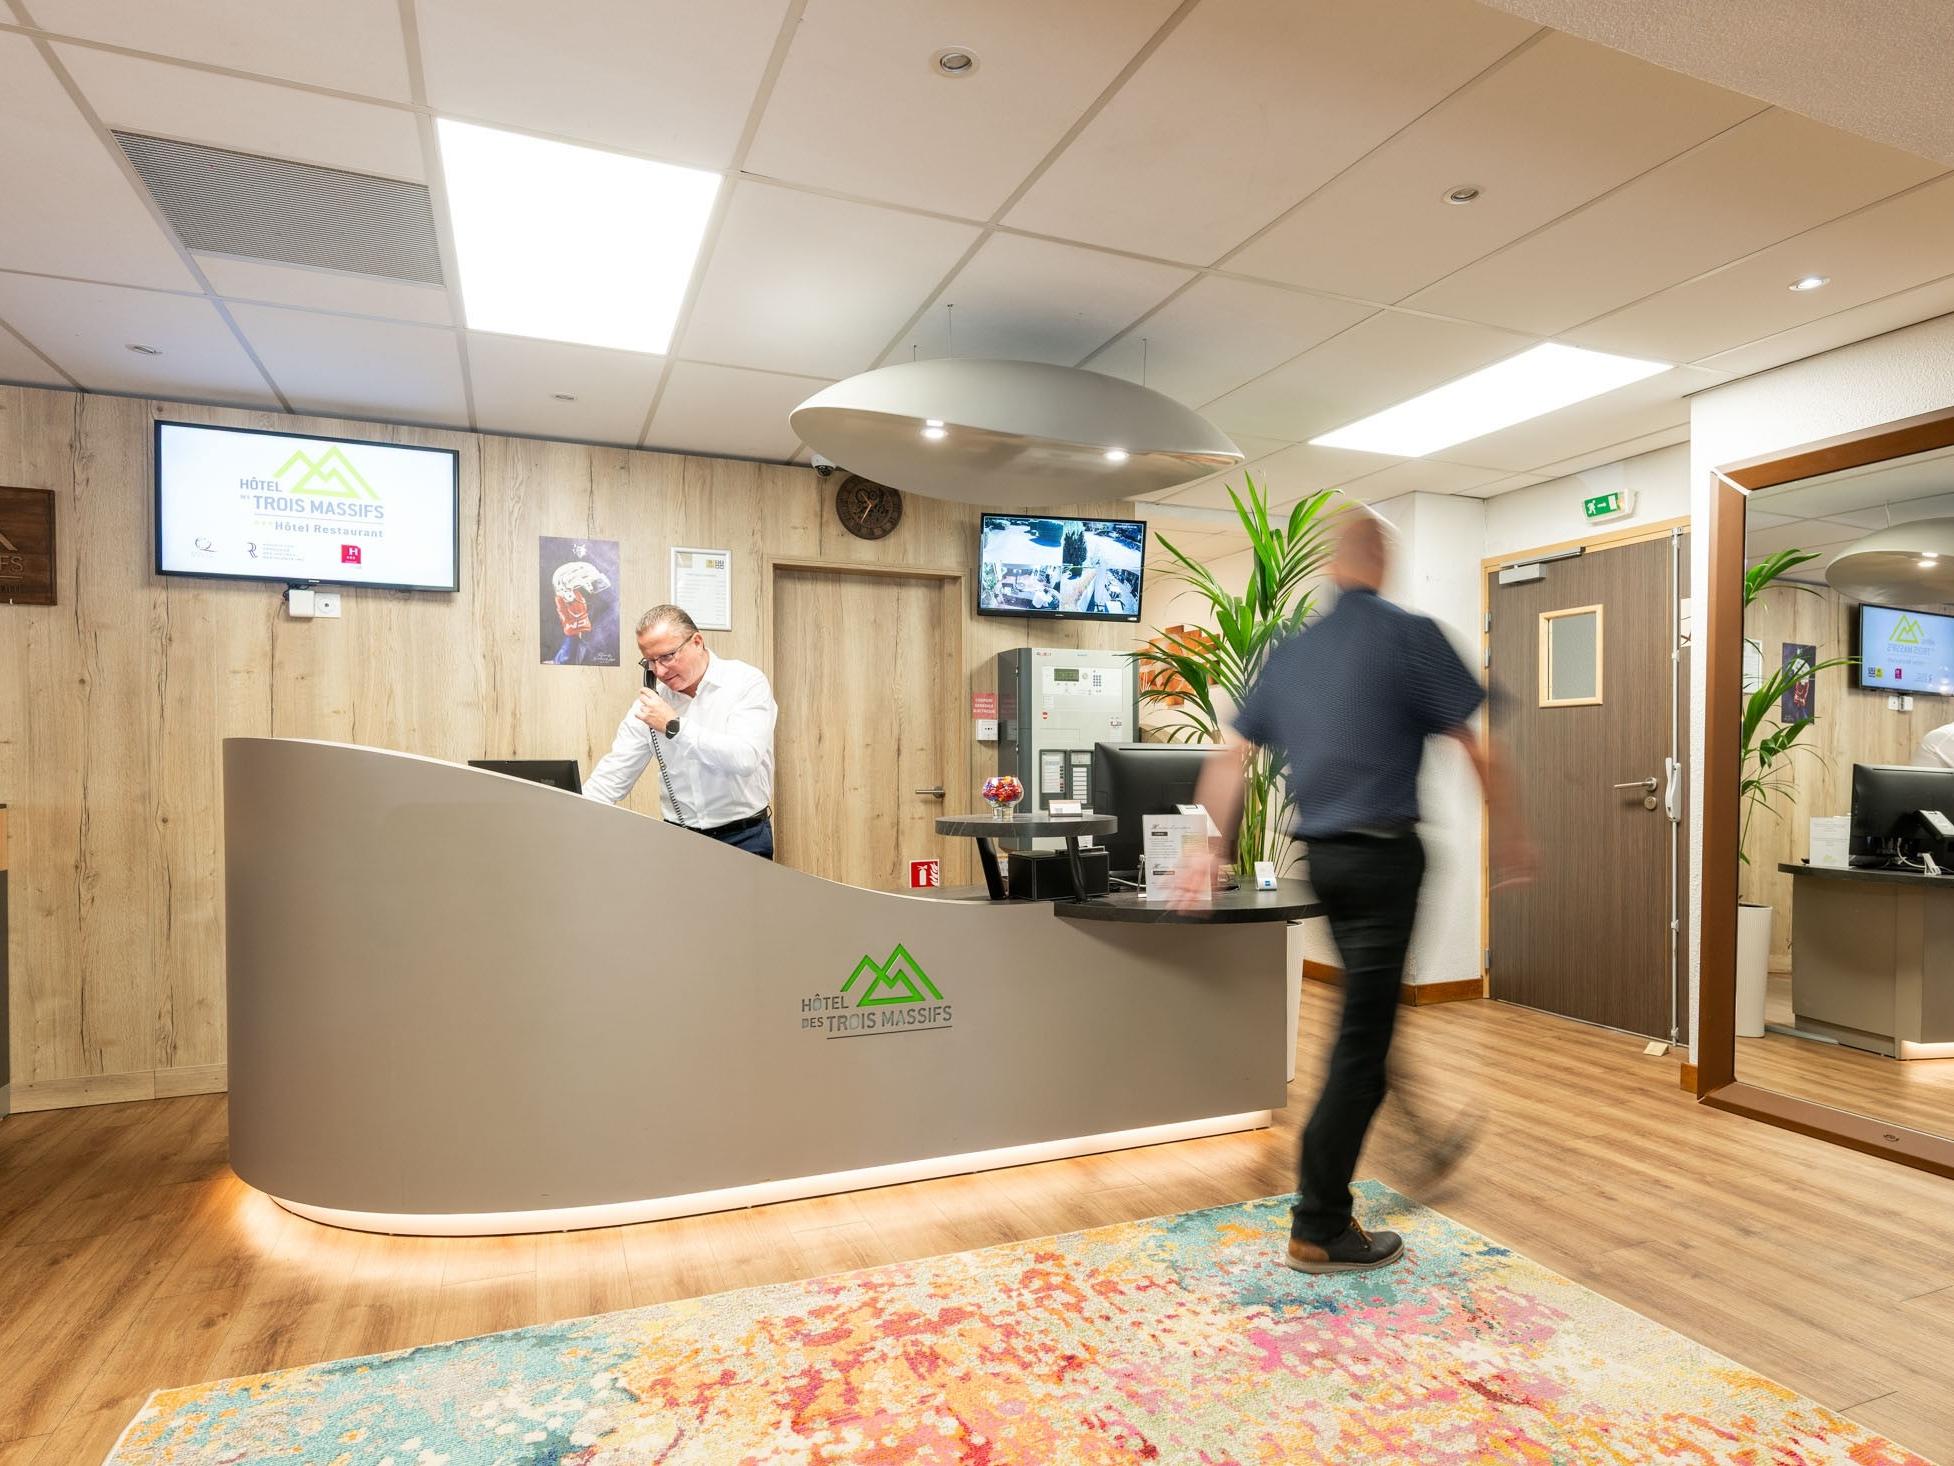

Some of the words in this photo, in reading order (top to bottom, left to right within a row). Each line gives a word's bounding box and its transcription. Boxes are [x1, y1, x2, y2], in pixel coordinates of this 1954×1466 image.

[240, 476, 283, 493] HÔTEL
[253, 495, 305, 513] TROIS
[311, 500, 385, 519] MASSIFS
[275, 520, 309, 533] Hôtel
[314, 524, 384, 538] Restaurant
[801, 993, 849, 1012] HÔTEL
[801, 1016, 824, 1029] DES
[826, 1012, 876, 1032] TROIS
[881, 1005, 953, 1027] MASSIFS
